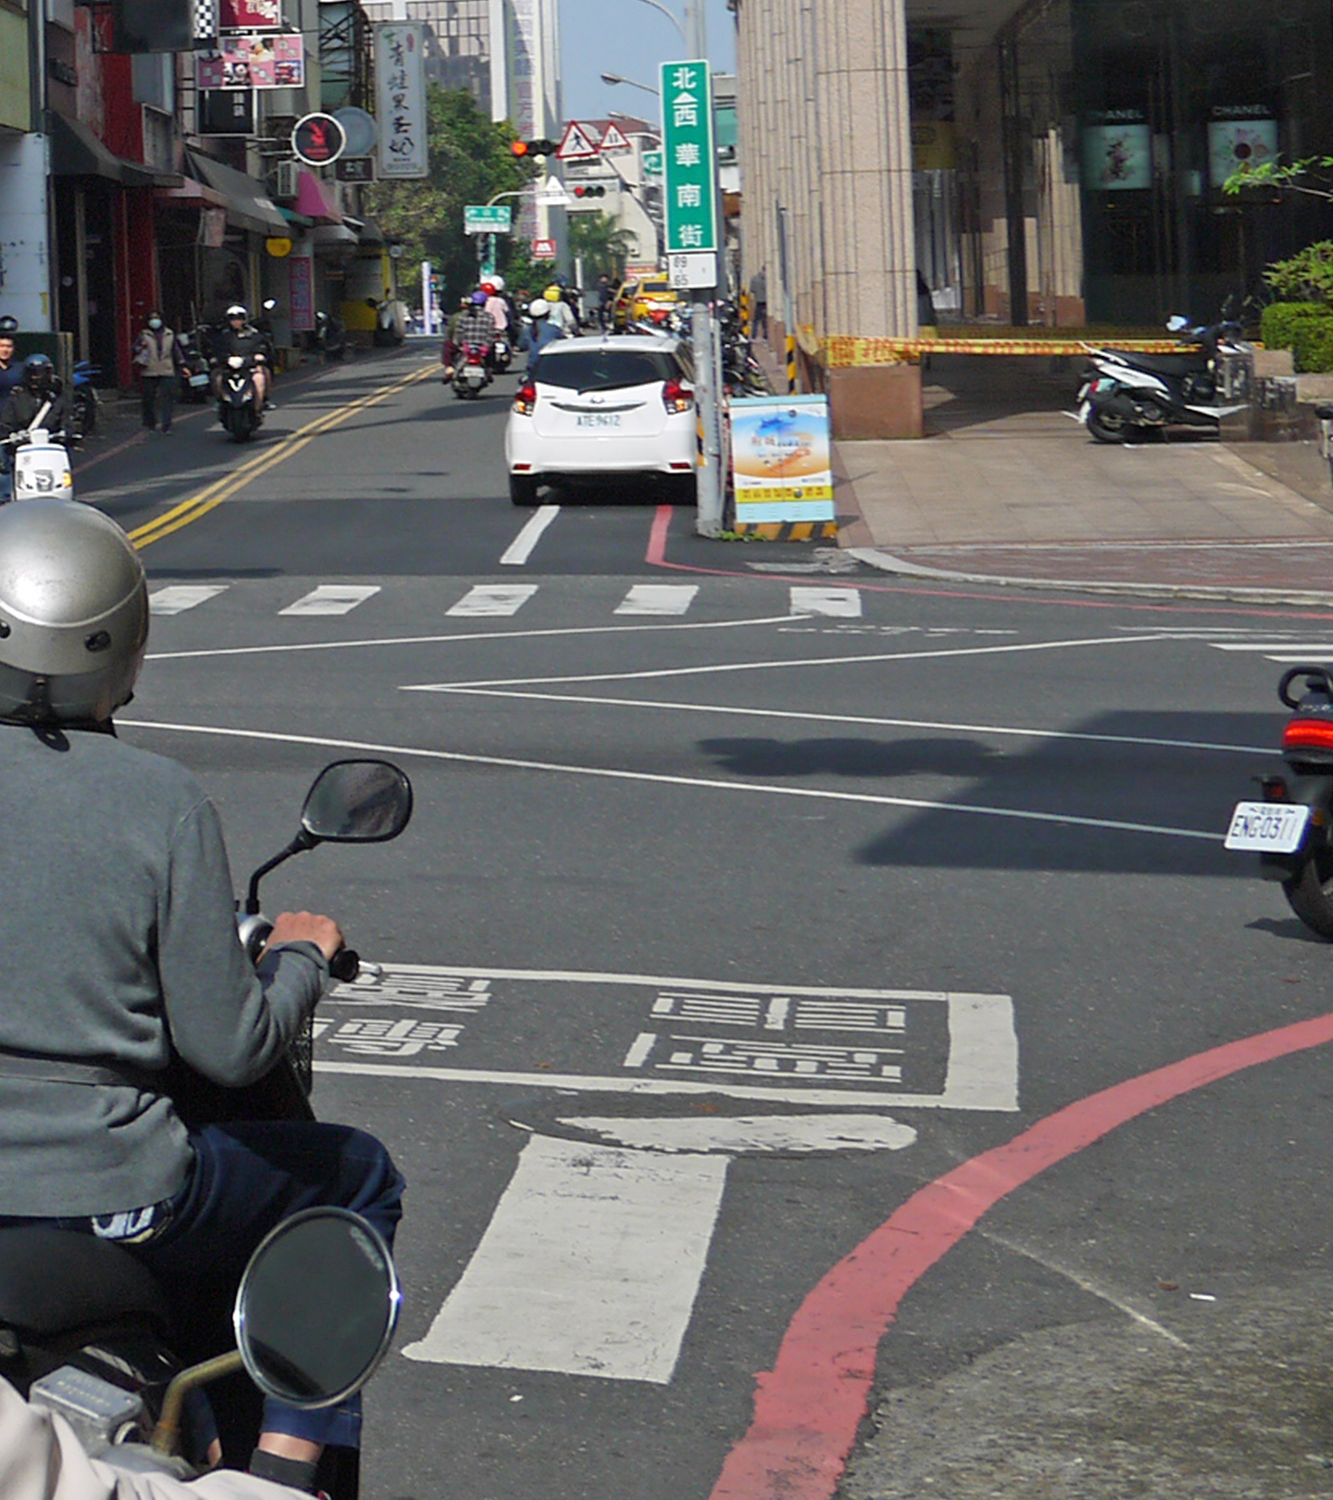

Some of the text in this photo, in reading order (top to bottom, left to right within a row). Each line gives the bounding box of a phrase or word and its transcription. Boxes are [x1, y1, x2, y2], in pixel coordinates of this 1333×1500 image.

[672, 67, 696, 89] 北
[673, 105, 704, 246] 西華南街
